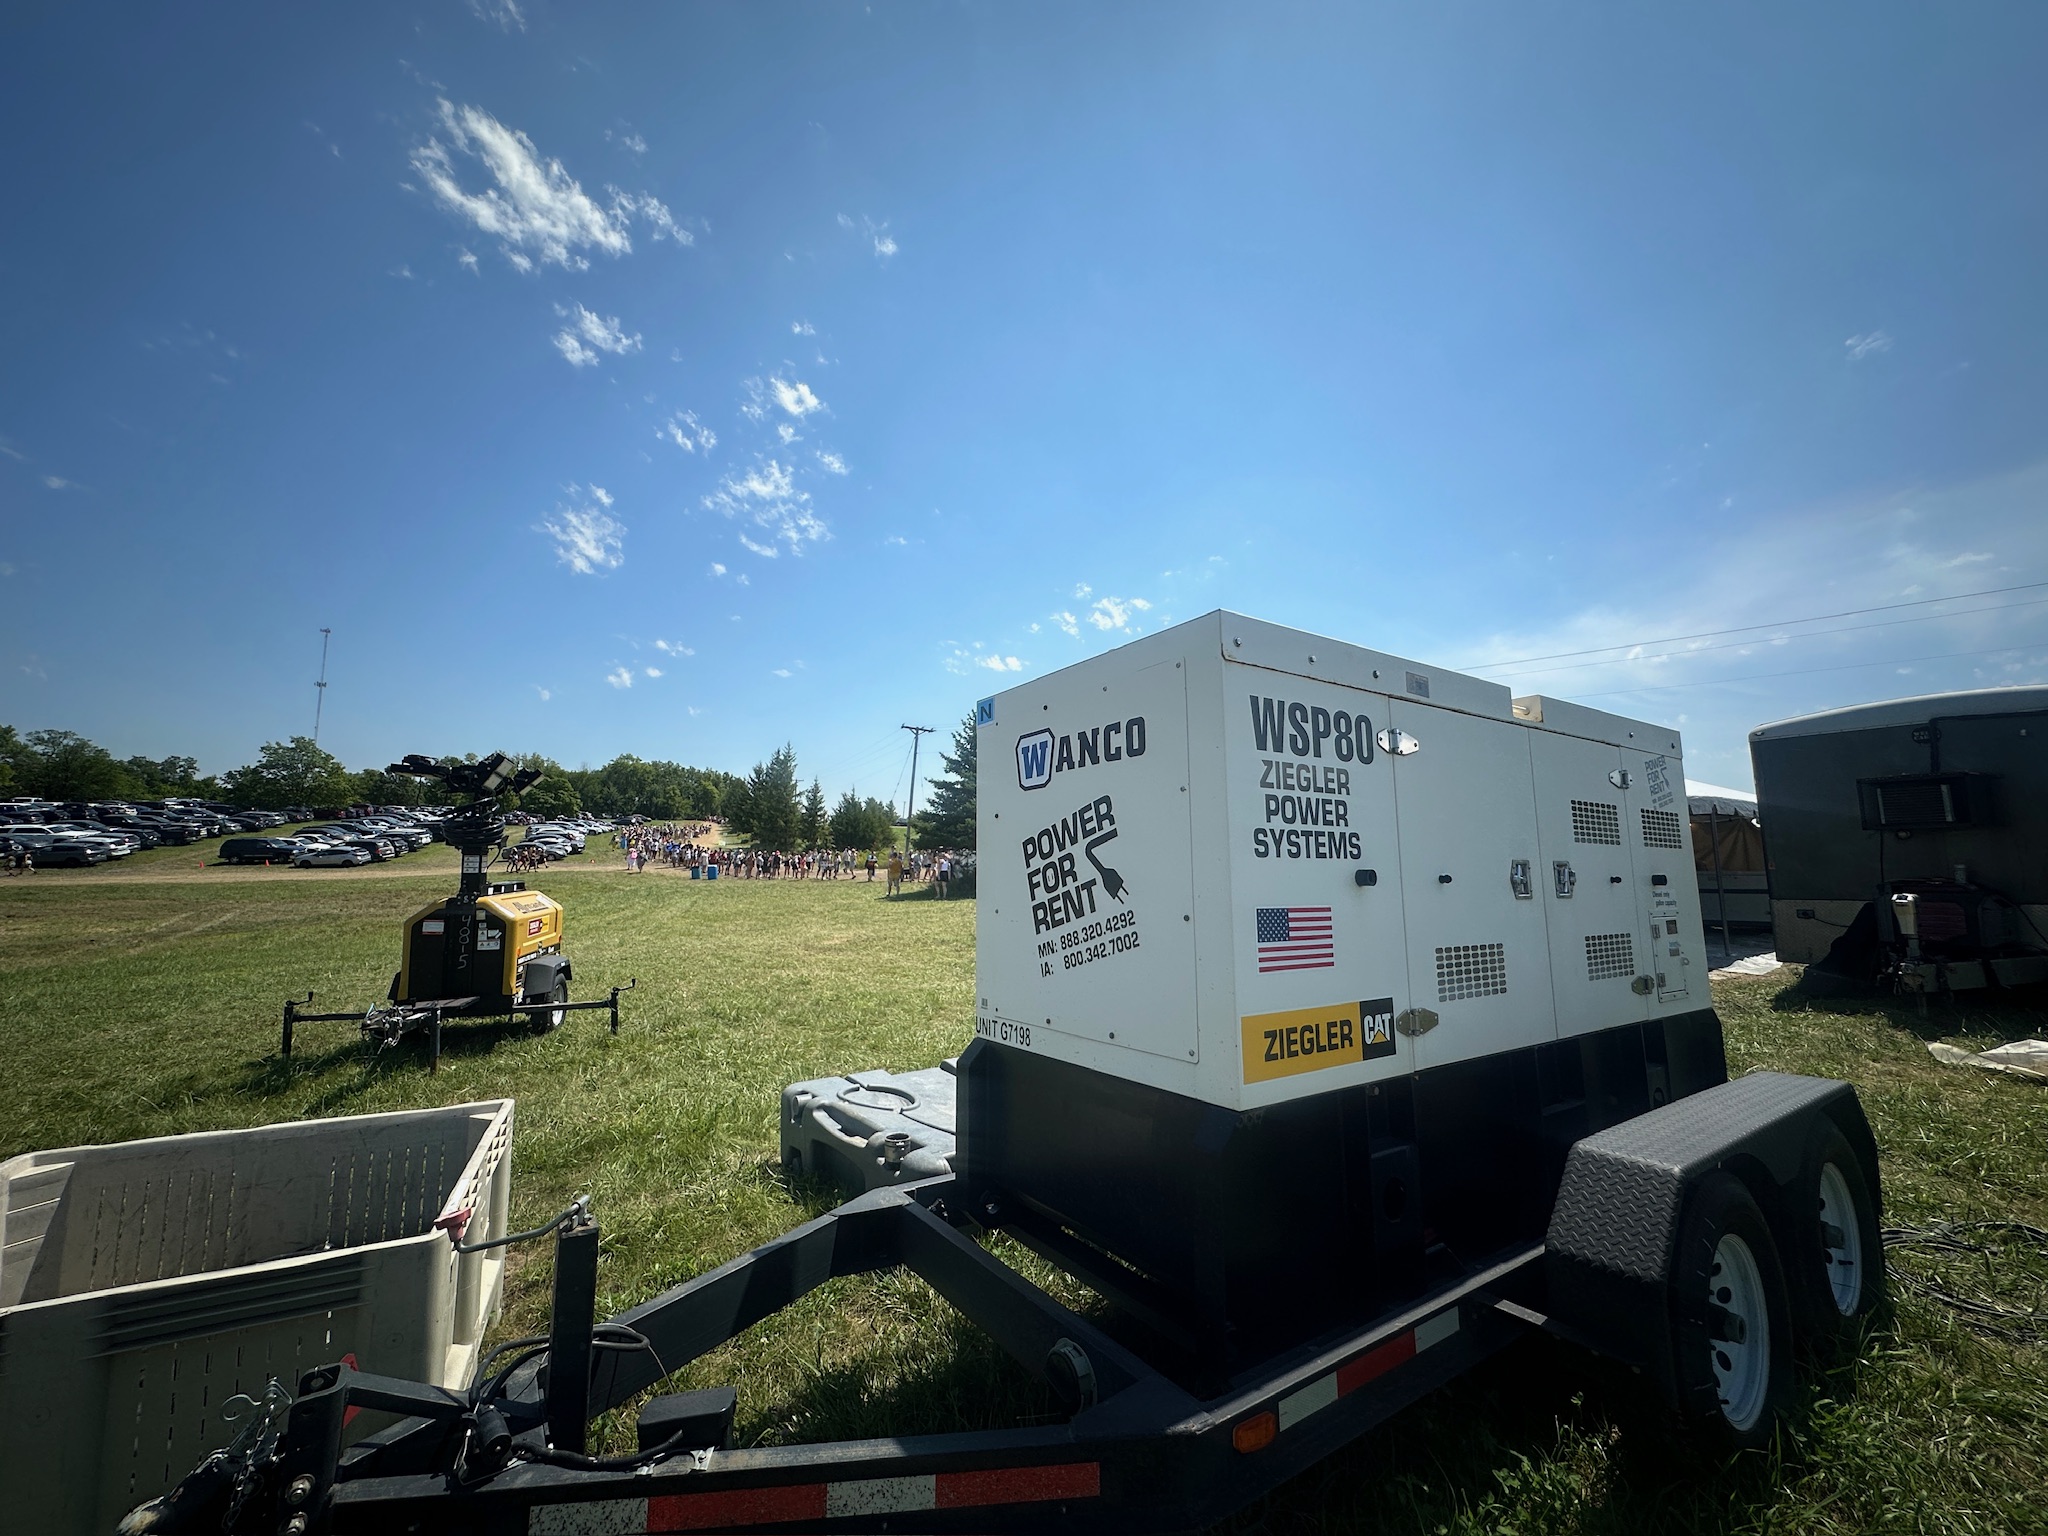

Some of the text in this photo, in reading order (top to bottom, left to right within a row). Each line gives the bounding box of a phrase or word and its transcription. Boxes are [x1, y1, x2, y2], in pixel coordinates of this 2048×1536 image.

[980, 702, 992, 722] N
[1249, 695, 1375, 765] WSP80
[1017, 716, 1146, 785] WANCO
[1645, 755, 1666, 772] POWER
[1259, 759, 1351, 796] ZIEGLER
[1647, 770, 1660, 784] FOR
[1650, 780, 1665, 796] RENT
[1021, 794, 1116, 869] POWER
[1264, 794, 1349, 828] POWER
[1253, 827, 1362, 860] SYSTEMS
[1026, 852, 1077, 902] FOR
[1031, 877, 1097, 935] RENT
[1037, 909, 1136, 959] MN: 888.320.4292
[1040, 931, 1140, 978] IA: 800.342.7002
[976, 1015, 1031, 1047] UNIT G7198
[1263, 1012, 1393, 1063] ZIEGLER CAT
